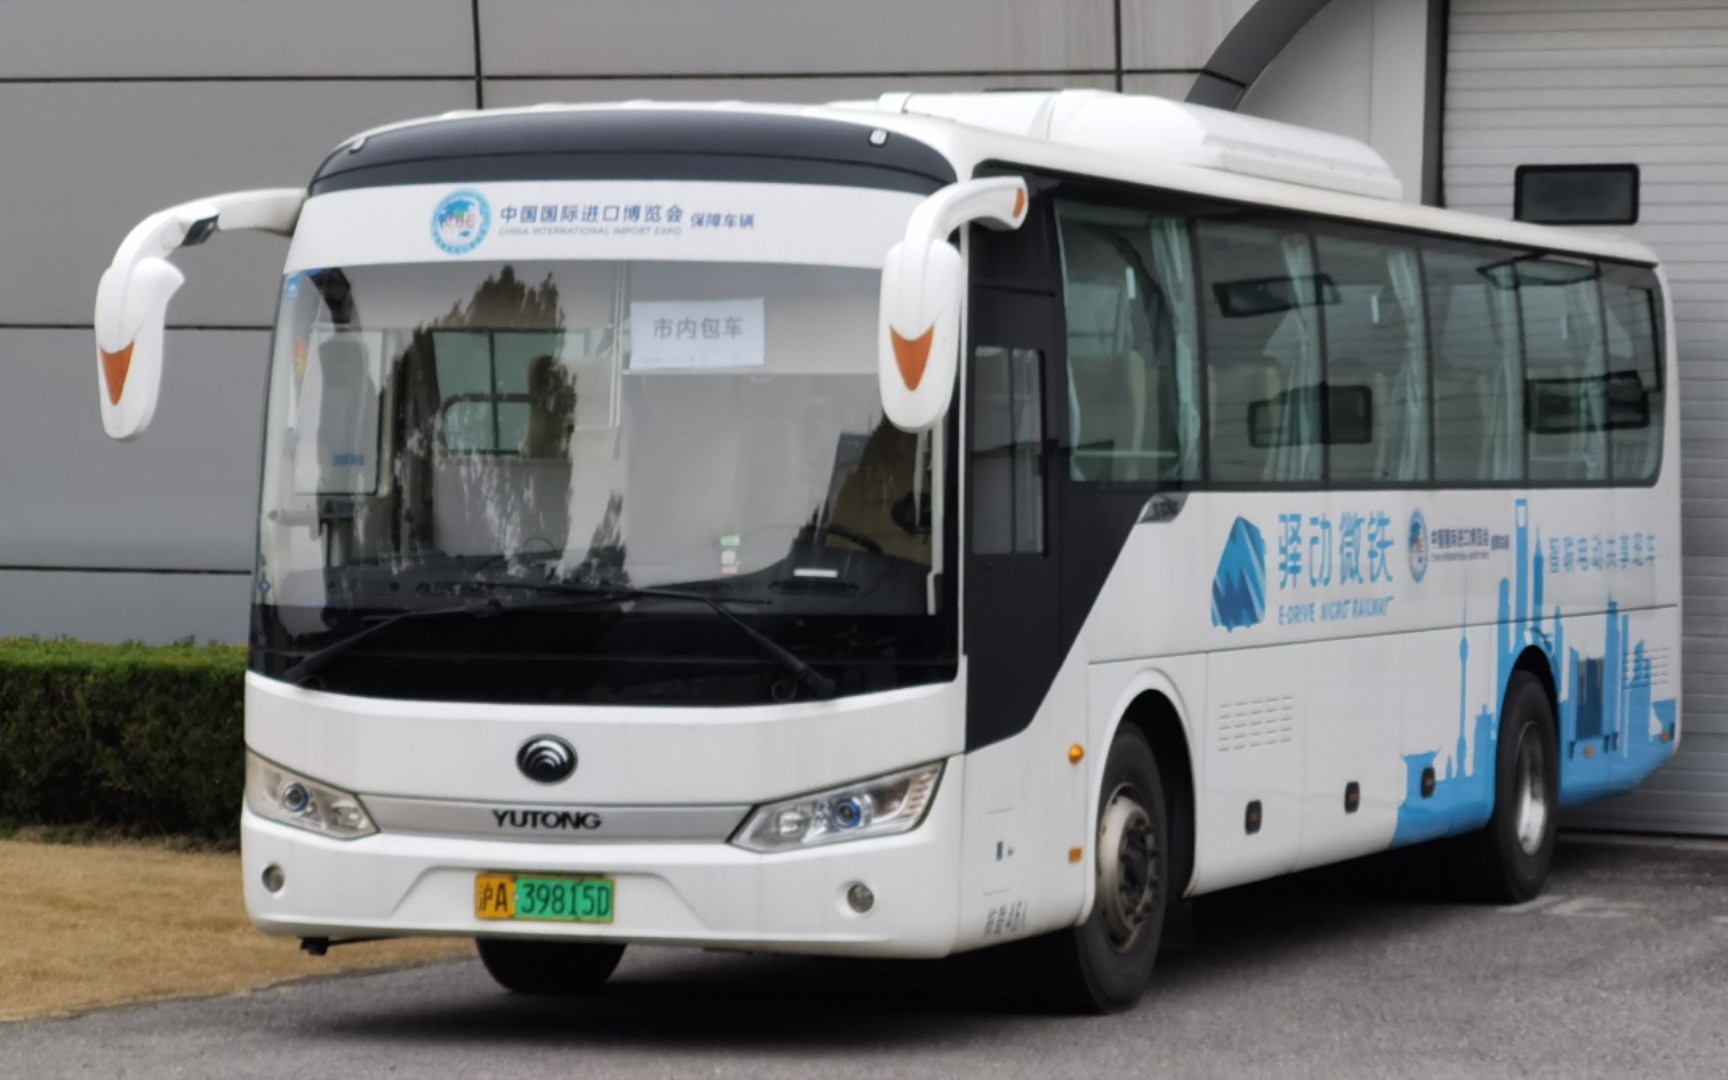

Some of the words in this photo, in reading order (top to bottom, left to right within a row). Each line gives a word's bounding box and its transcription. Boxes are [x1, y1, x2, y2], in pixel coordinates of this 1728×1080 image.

[500, 203, 684, 223] 中国国际进口博览会
[690, 211, 756, 230] 保障车辆
[498, 226, 529, 236] CHINA
[532, 226, 609, 236] INTERNATIONAL
[613, 226, 652, 236] IMPORT
[654, 226, 682, 236] EXPO
[653, 316, 744, 340] 市内包车
[1278, 510, 1395, 590] 驿动微铁
[492, 809, 602, 830] YUTONG
